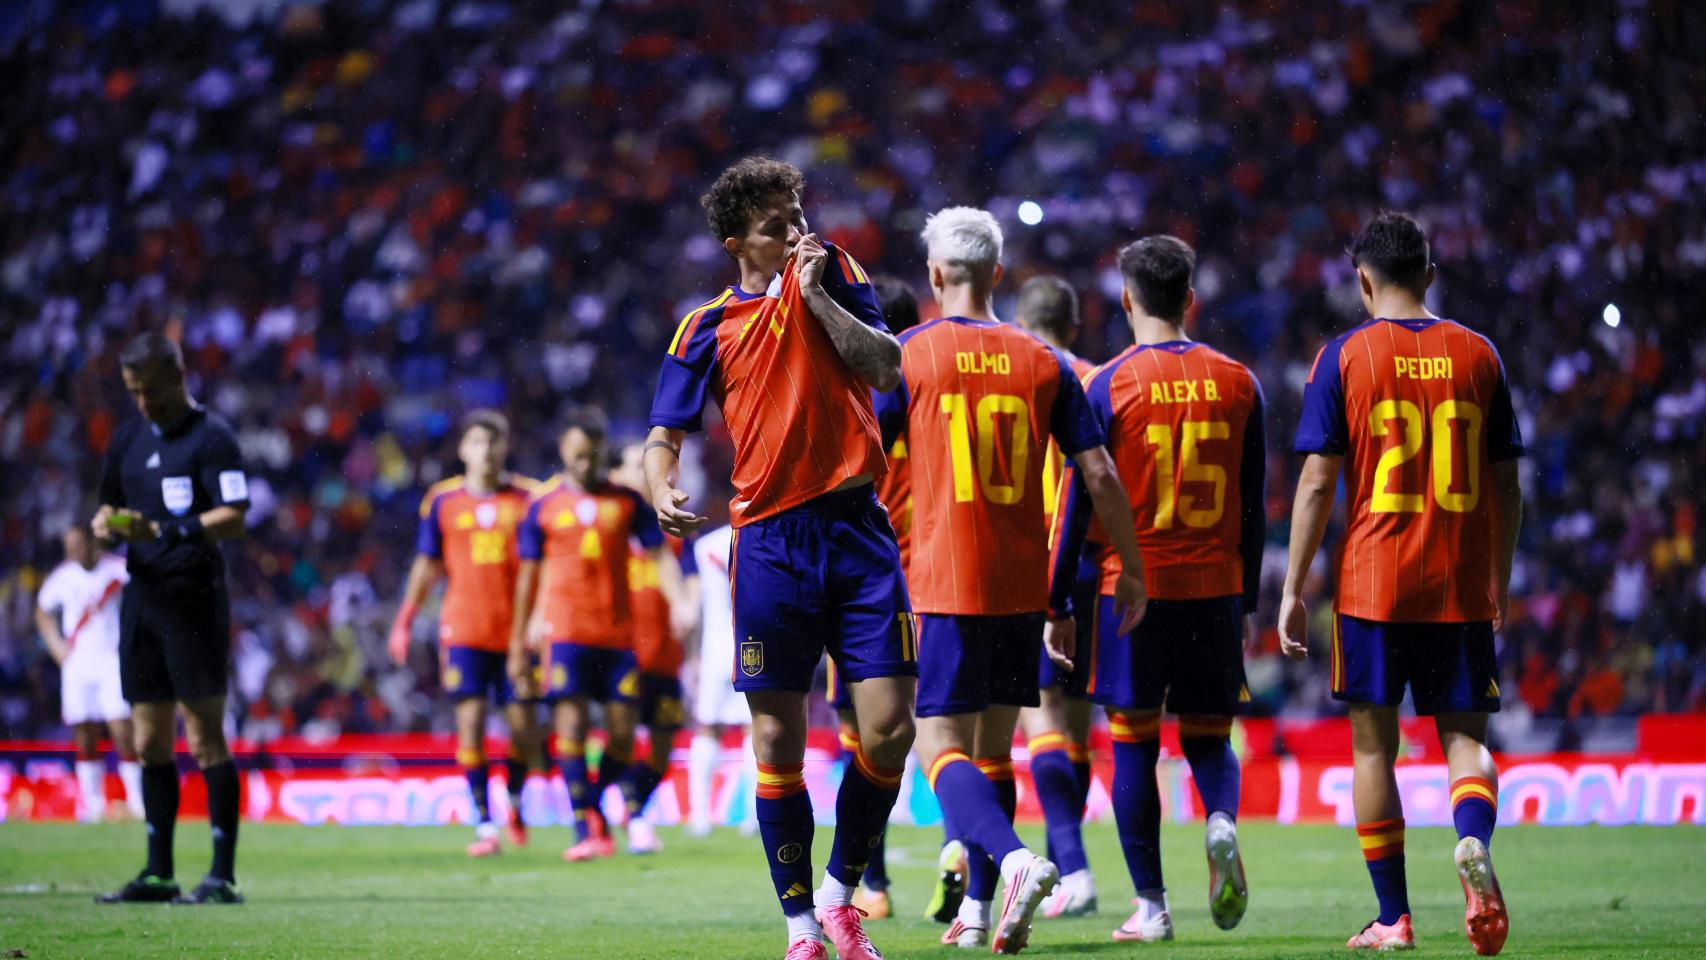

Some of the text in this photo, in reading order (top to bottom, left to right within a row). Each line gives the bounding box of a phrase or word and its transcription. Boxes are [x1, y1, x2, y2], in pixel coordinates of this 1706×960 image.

[956, 352, 1010, 375] OLMO
[1150, 379, 1222, 405] ALEX B.
[1394, 356, 1452, 380] PEDRI
[940, 394, 1029, 505] 10
[1147, 421, 1230, 529] 15
[1369, 399, 1482, 513] 20
